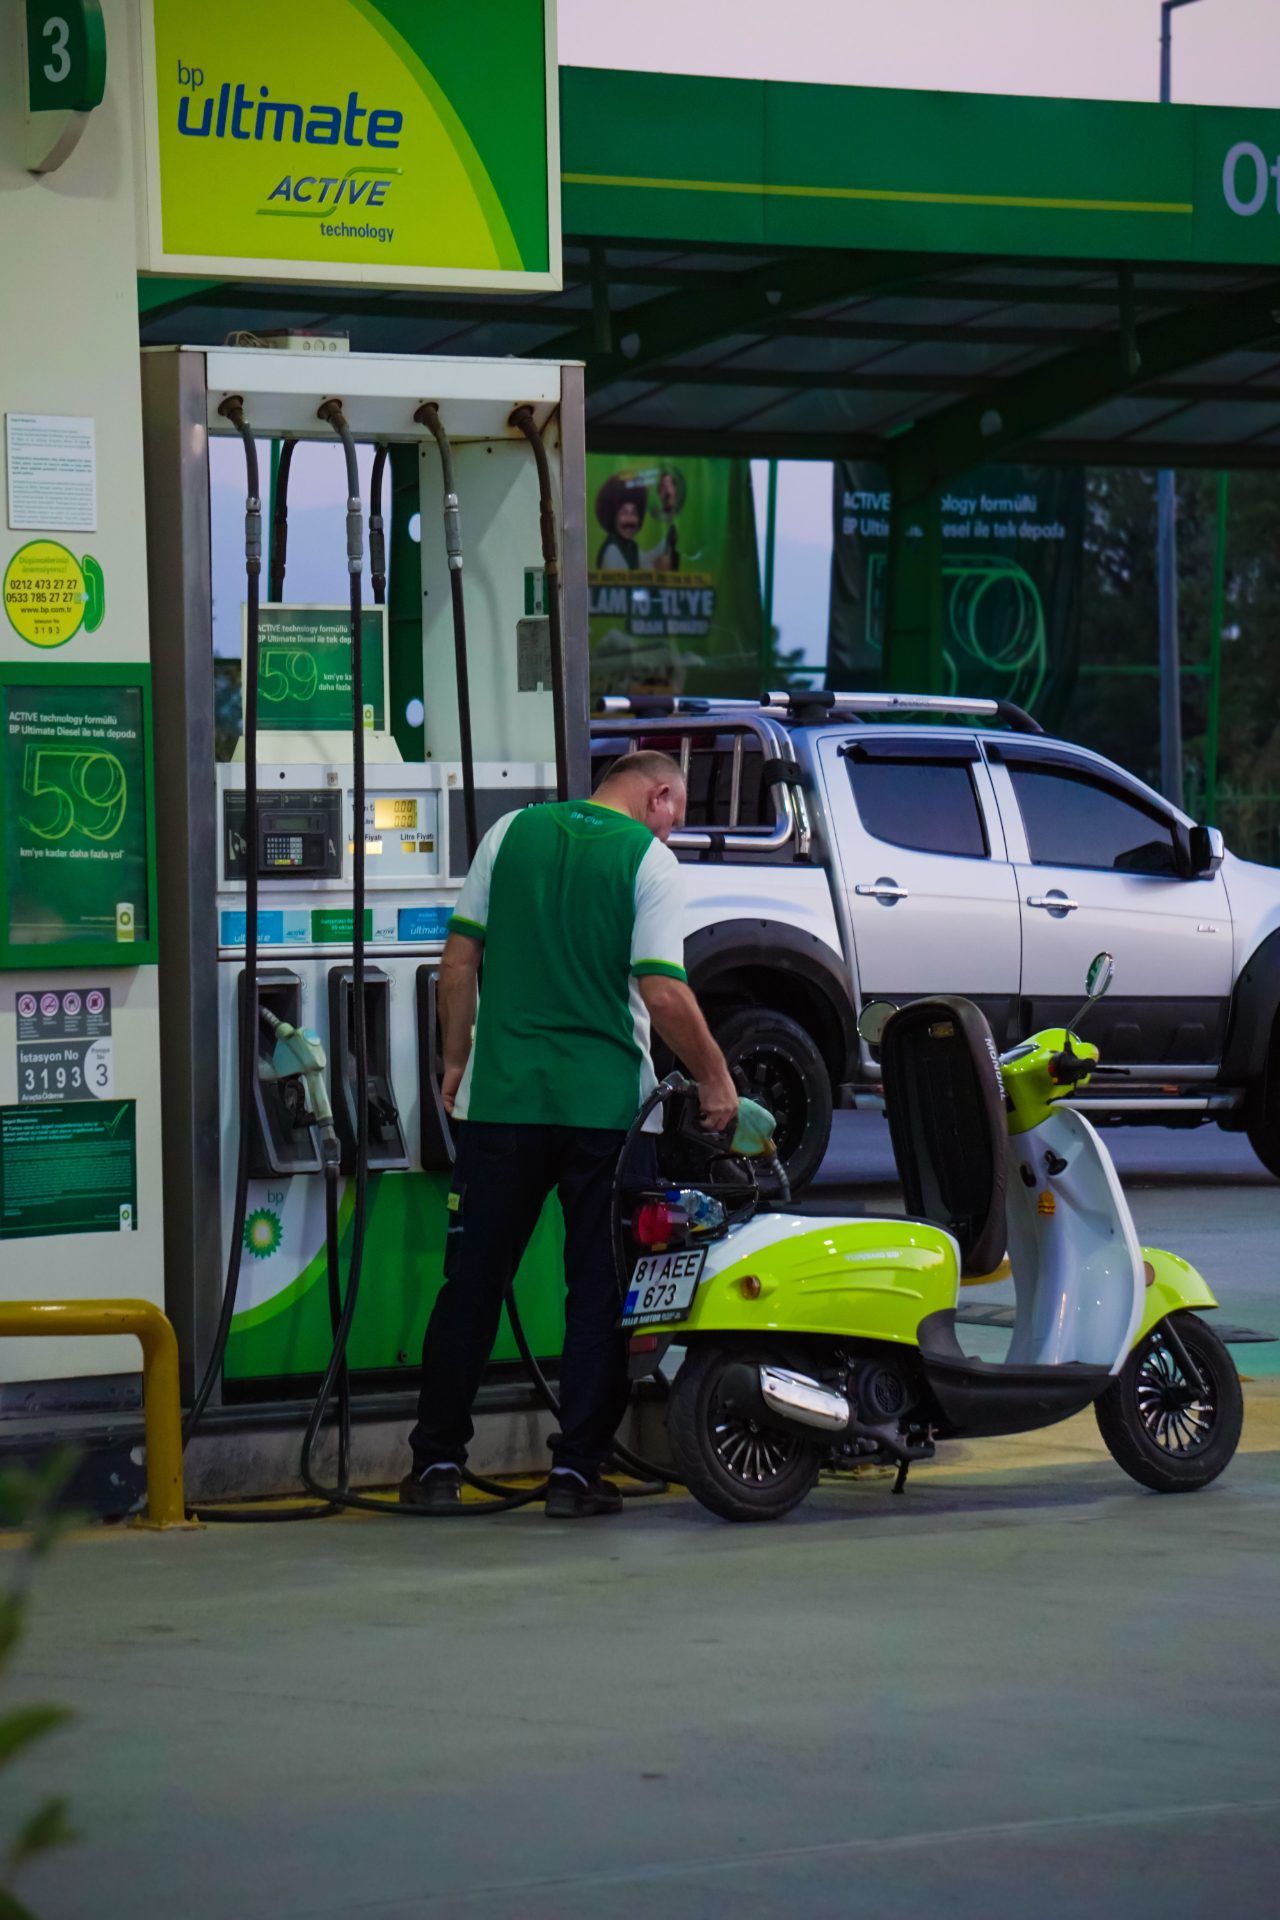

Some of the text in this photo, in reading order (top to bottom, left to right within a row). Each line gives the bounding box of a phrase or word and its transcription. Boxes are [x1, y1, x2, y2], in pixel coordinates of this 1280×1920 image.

[43, 16, 71, 83] 3
[177, 59, 204, 91] bp
[177, 82, 403, 149] ultimate
[266, 175, 391, 207] ACTIVE
[320, 222, 394, 243] technology
[974, 520, 990, 538] ile
[994, 520, 1016, 538] tek
[10, 579, 78, 590] 0212 473 27 27
[6, 592, 73, 603] 0533 785 27 27
[20, 606, 72, 614] www.bp.com.tr
[282, 624, 318, 635] technology
[319, 624, 348, 633] formüllü
[267, 635, 296, 643] Ultimate
[326, 636, 338, 644] tek
[339, 637, 352, 646] dep
[258, 647, 318, 701] 59
[318, 683, 351, 691] daha fazla
[9, 711, 117, 725] ACTIVE technology formüllü
[9, 725, 136, 739] BP Ultimate Diesel ile tek depoda
[19, 743, 127, 840] 59
[20, 848, 43, 859] km'ye
[45, 848, 67, 857] kadar
[69, 849, 89, 858] daha
[90, 849, 108, 859] fazla
[410, 925, 445, 936] ultimate
[20, 1050, 79, 1063] İstasyon No
[96, 1063, 108, 1087] 3
[985, 1038, 1006, 1101] MONDIAL
[267, 1189, 284, 1206] bp
[636, 1254, 700, 1283] 81 AEE
[643, 1283, 677, 1309] 673
